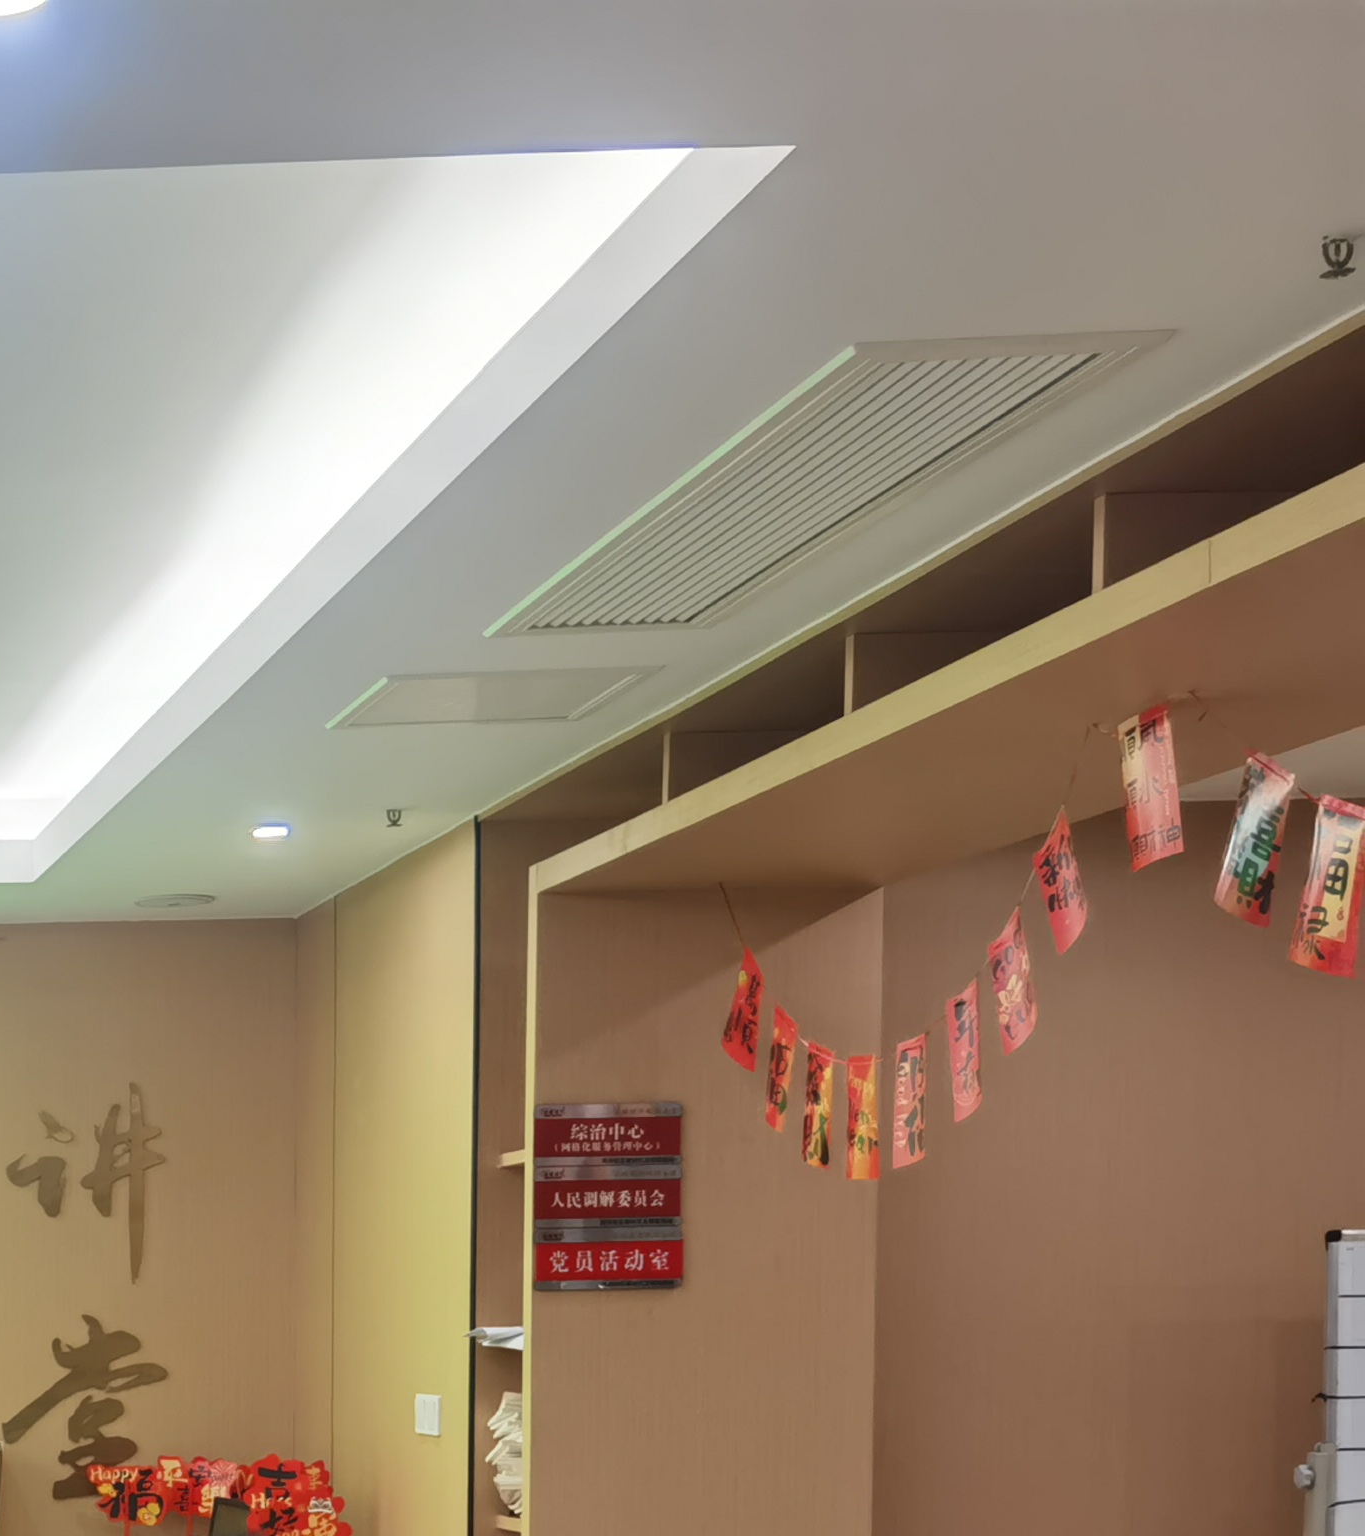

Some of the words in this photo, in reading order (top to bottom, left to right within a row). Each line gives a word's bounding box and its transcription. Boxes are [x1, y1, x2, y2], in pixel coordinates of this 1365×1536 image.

[570, 1122, 645, 1141] 综治中心
[550, 1189, 666, 1209] 人民调解委员会
[548, 1249, 670, 1274] 党员活动室
[90, 1465, 139, 1483] Happy
